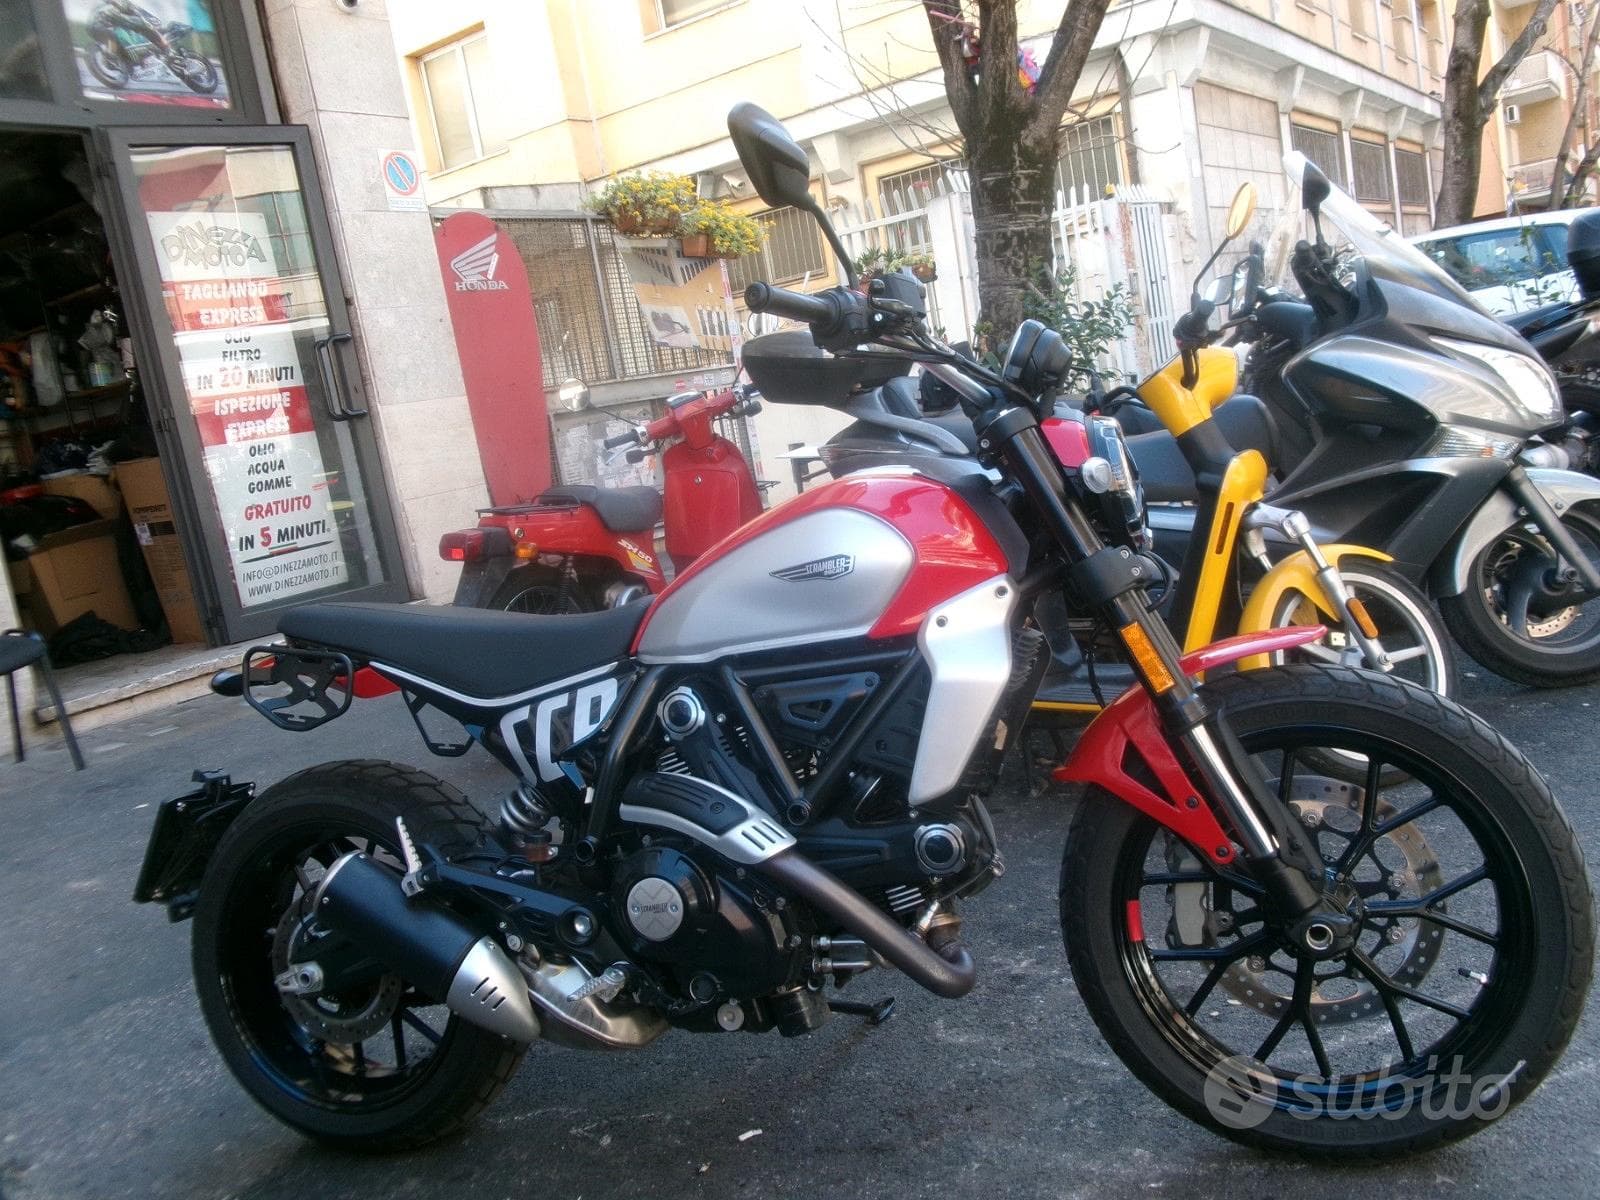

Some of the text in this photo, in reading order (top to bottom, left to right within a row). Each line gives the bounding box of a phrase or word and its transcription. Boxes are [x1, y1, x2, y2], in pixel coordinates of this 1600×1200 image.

[182, 281, 268, 300] TAGLIANDO
[455, 280, 509, 291] HONDA
[222, 348, 261, 362] FILTRO
[197, 366, 294, 390] IN 20 MINUTI
[214, 392, 290, 416] ISPEZIONE
[249, 443, 275, 457] OLIO
[248, 459, 285, 476] ACQUA
[248, 476, 292, 494] GOMME
[244, 495, 312, 520] GRATUITO
[239, 535, 254, 552] IN
[260, 526, 272, 548] 5
[242, 551, 338, 584] INFO@DINEZZAMOTO.IT
[805, 558, 846, 574] SCRAMBLER
[248, 567, 340, 597] WWW.DINEZZAMOTO.IT
